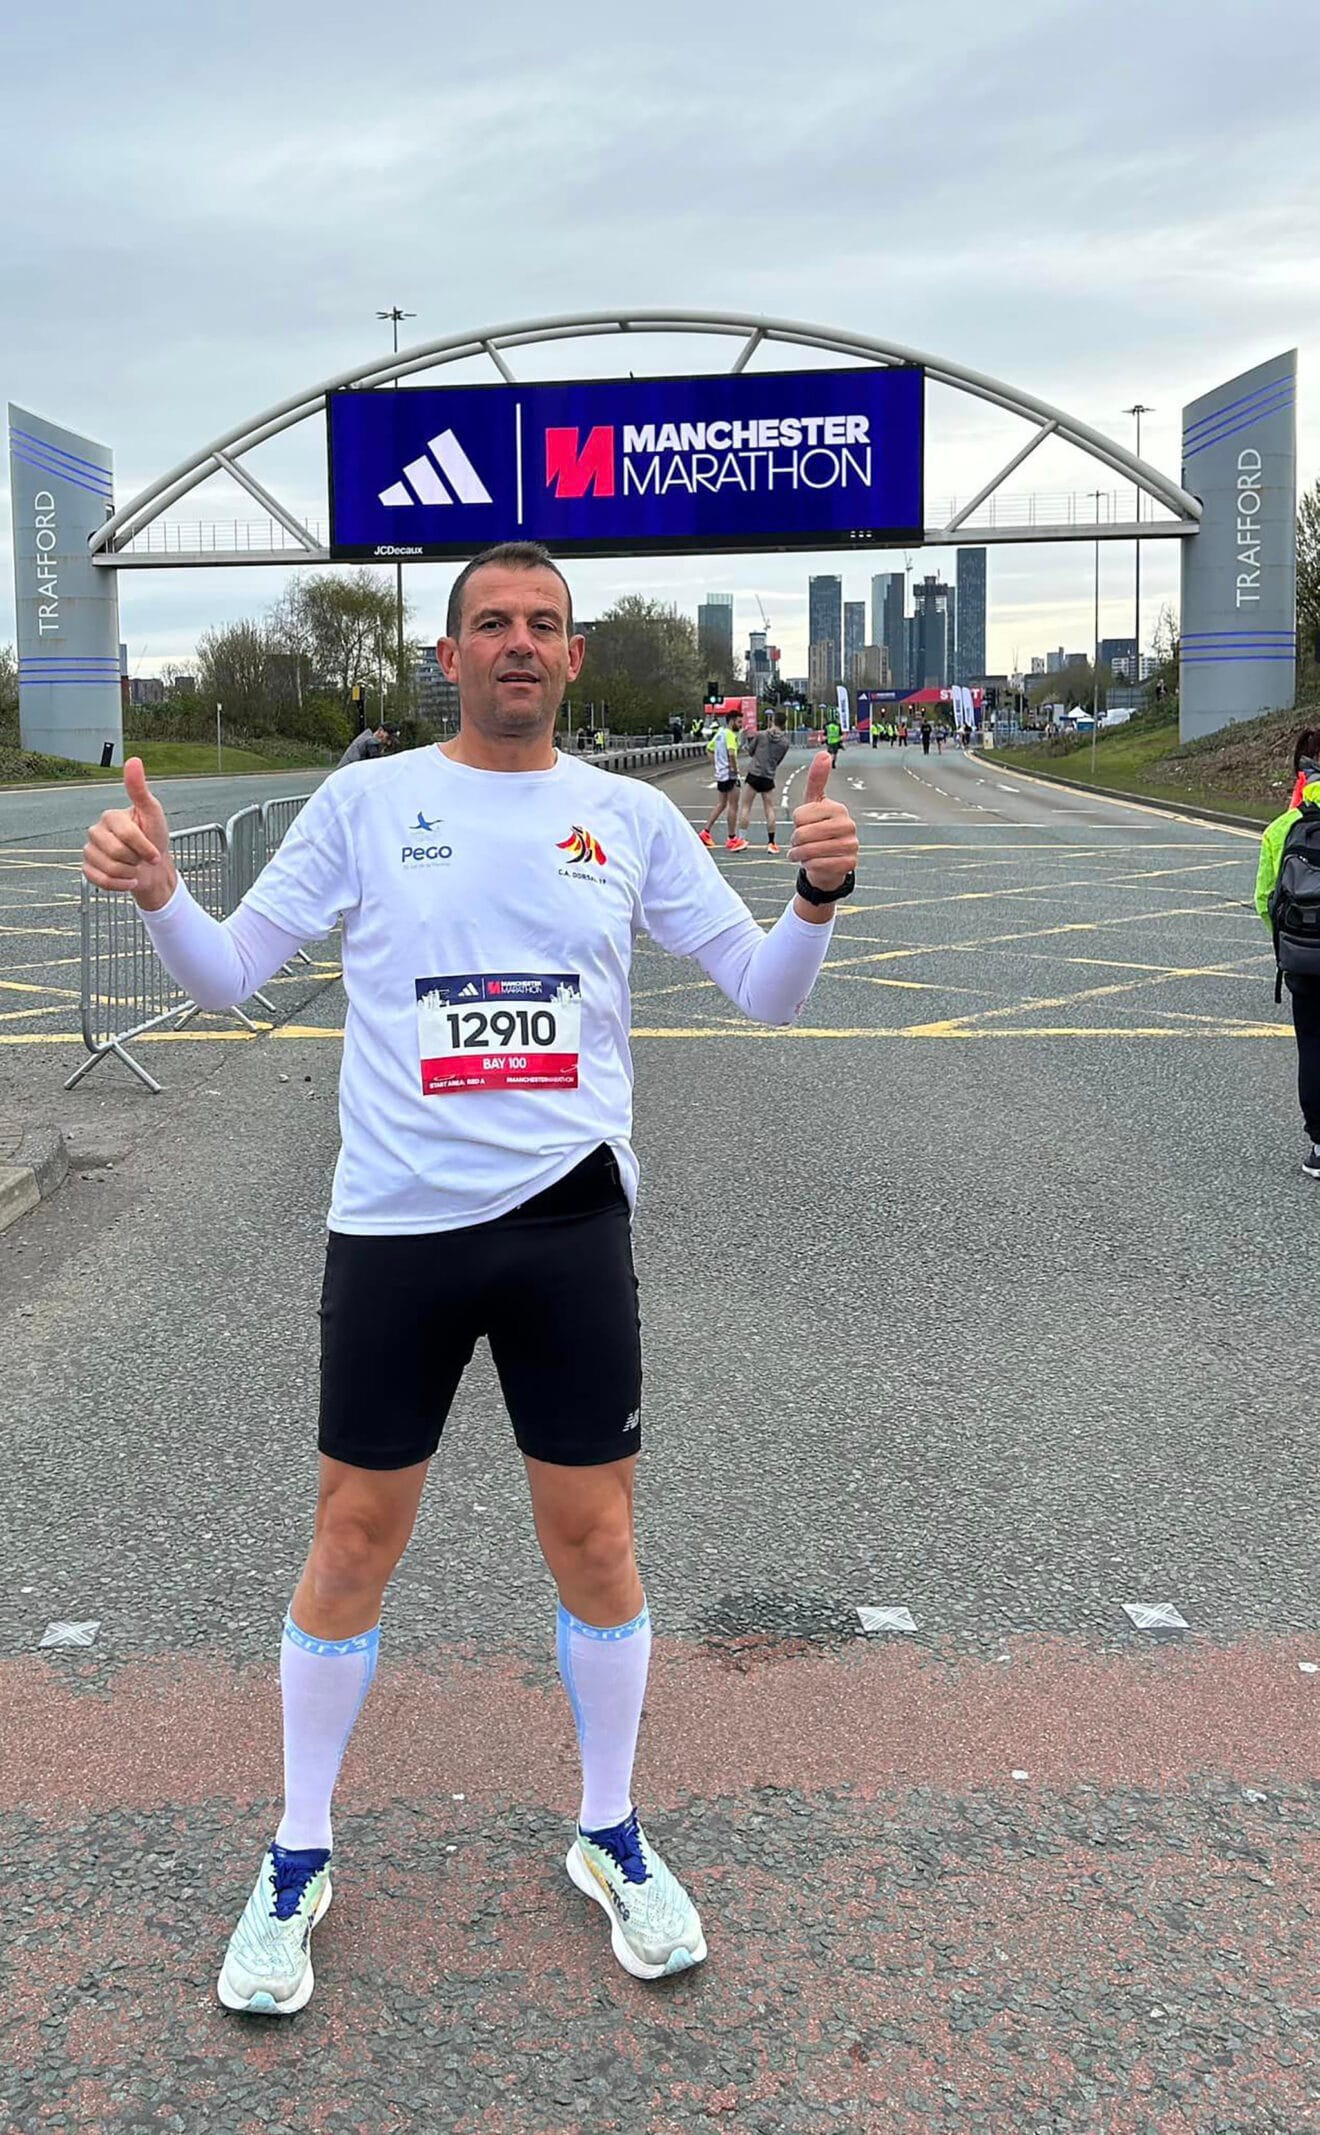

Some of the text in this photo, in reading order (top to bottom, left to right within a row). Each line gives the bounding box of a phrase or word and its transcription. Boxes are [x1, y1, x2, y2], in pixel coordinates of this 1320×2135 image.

[622, 414, 871, 453] MANCHESTER
[622, 446, 872, 496] MARATHON
[1236, 448, 1262, 608] TRAFFORD
[34, 490, 60, 636] TRAFFORD
[373, 545, 423, 556] JCDecaux
[940, 689, 980, 700] STT
[446, 1010, 556, 1049] 12910
[483, 1057, 527, 1070] BAY 100
